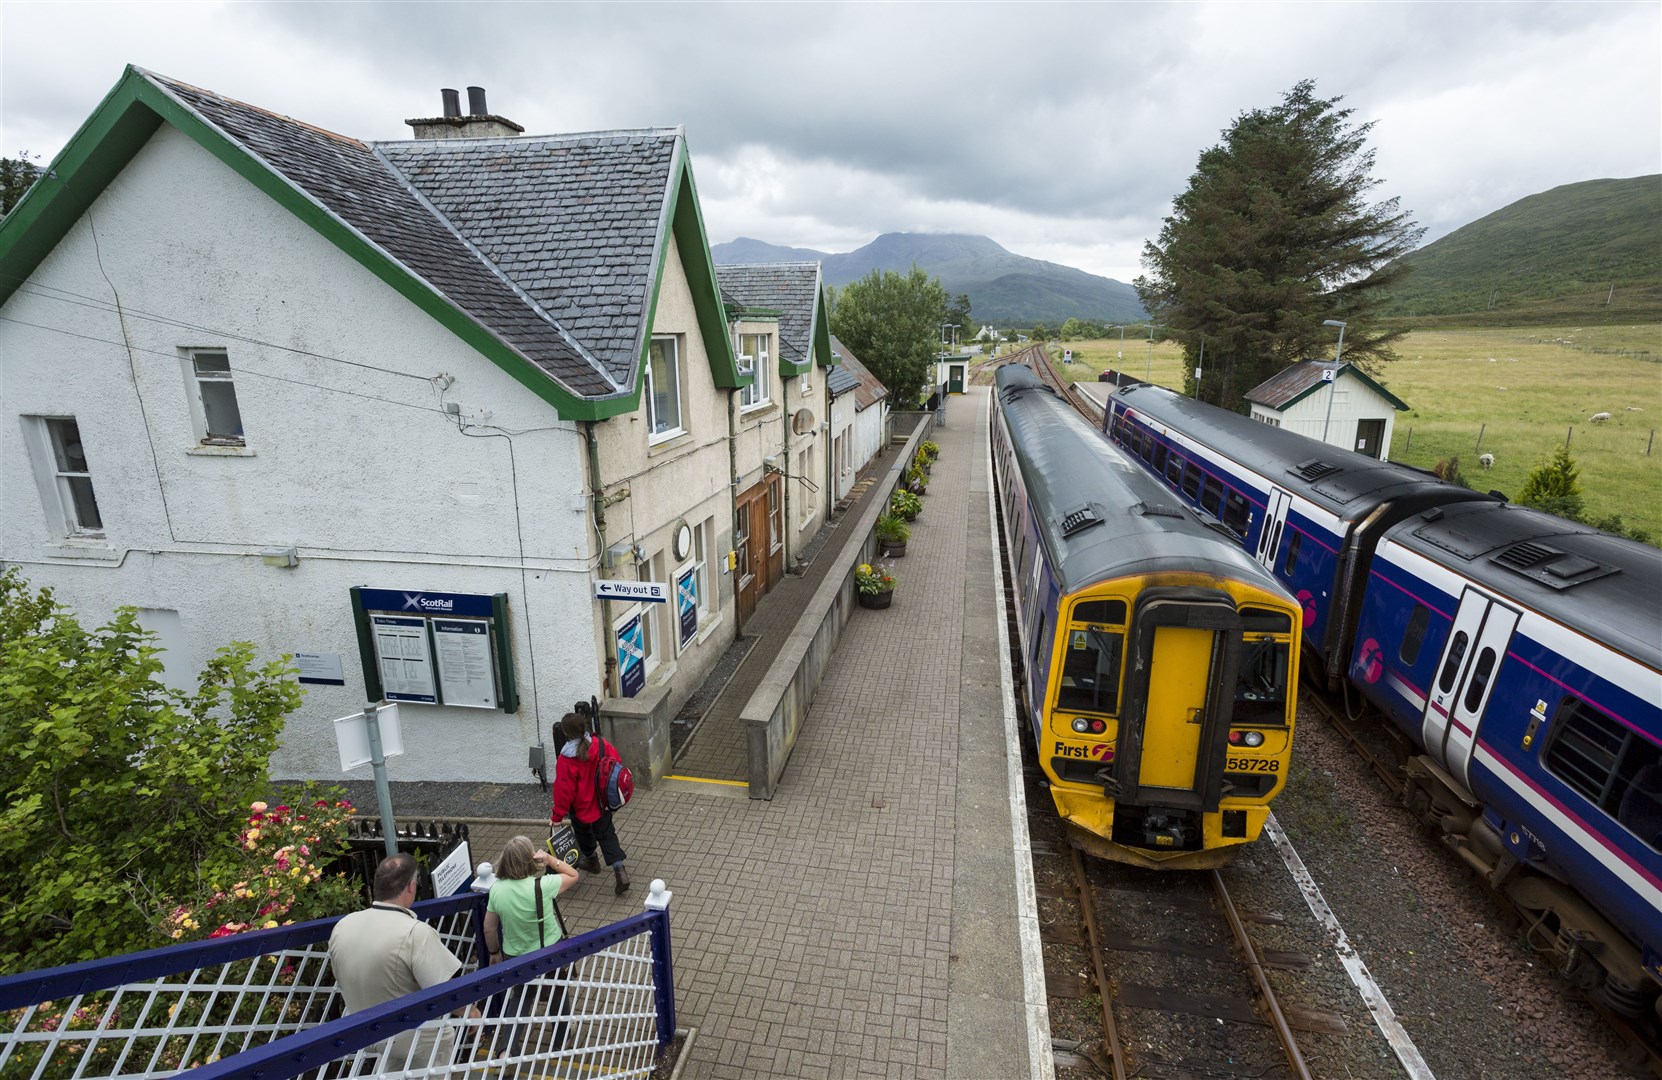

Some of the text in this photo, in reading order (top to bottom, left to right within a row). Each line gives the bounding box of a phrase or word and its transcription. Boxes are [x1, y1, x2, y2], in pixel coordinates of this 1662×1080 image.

[1326, 370, 1331, 380] 2
[614, 584, 648, 595] Way out
[420, 598, 453, 608] ScotRail
[1055, 741, 1089, 759] First
[555, 837, 577, 855] TASTE
